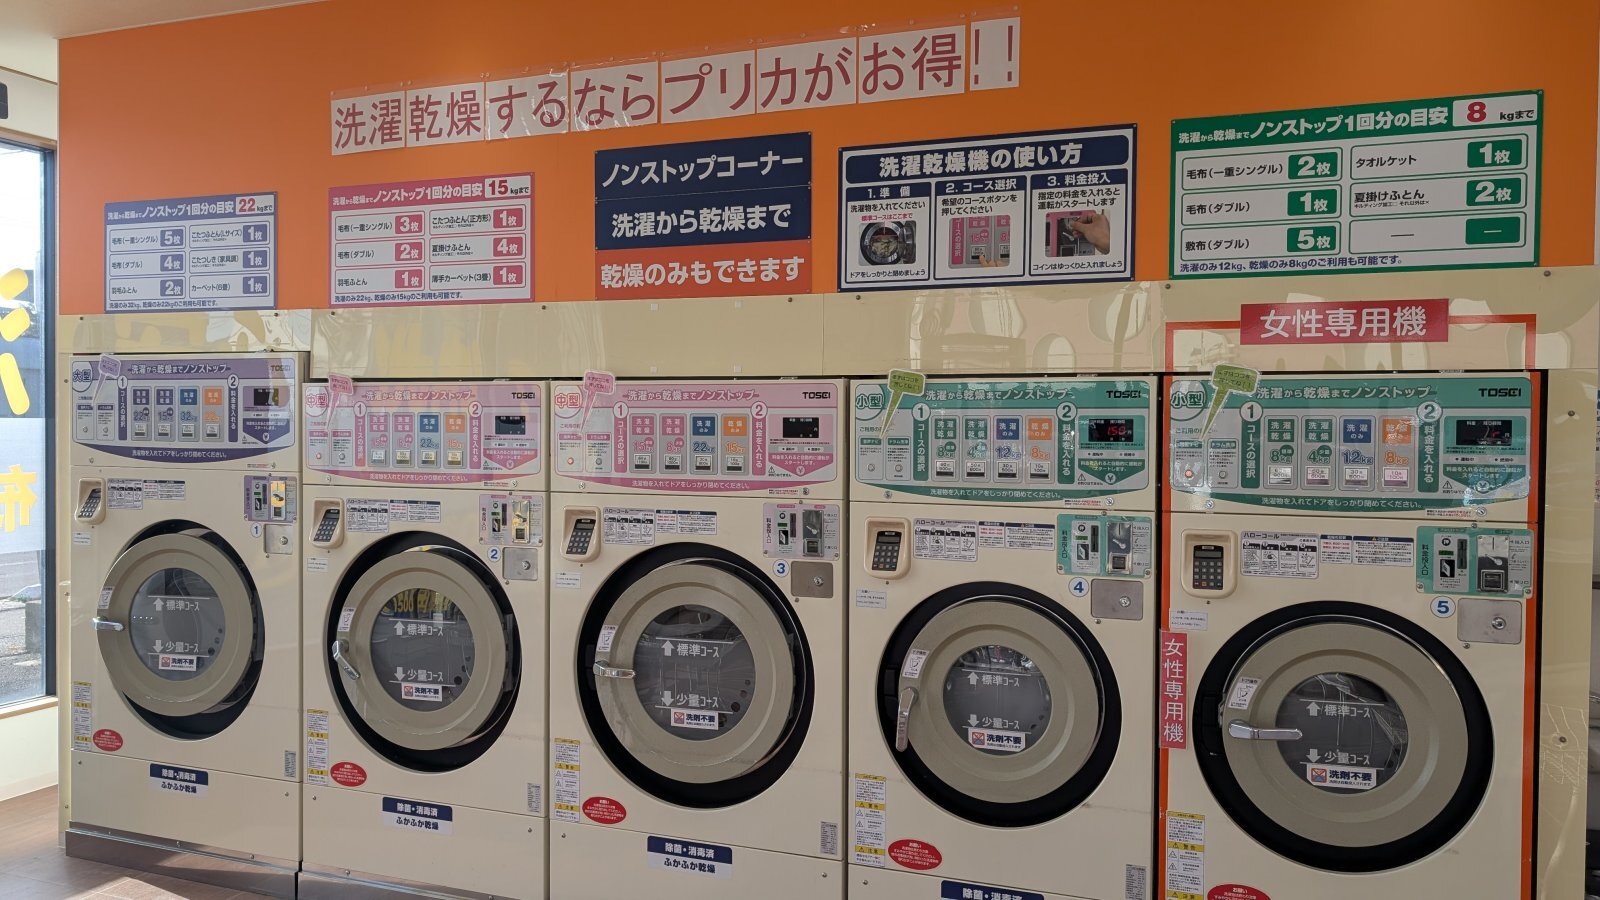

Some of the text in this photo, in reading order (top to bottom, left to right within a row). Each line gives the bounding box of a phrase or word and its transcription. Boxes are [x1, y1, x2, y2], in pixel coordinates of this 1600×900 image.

[1178, 102, 1534, 144] 洗濯から乾燥までノンストップ1回分の目安 8 kgまで
[879, 143, 1082, 178] 洗濯乾燥機の使い方
[1356, 143, 1510, 168] タオルケット 1枚
[602, 151, 803, 187] ノンストップコーナー
[1186, 156, 1331, 179] 毛布（一重シングル） 2枚
[962, 179, 1017, 192] コース選択
[1064, 173, 1110, 186] 料金投入
[489, 180, 508, 195] 15
[1038, 188, 1120, 200] 指定の料金を入れると
[1354, 181, 1512, 203] 夏掛けふとん 2枚
[238, 198, 255, 212] 22
[257, 204, 272, 212] kgまで
[850, 201, 926, 212] 洗濯物を入れてください
[942, 194, 1017, 206] 希望のコースボタンを
[1038, 198, 1116, 210] 運転がスタートします
[1186, 193, 1328, 215] 毛布（ダブル） 1枚
[942, 206, 992, 216] 押してください
[400, 217, 419, 232] 3枚
[500, 211, 516, 226] 1枚
[612, 204, 791, 238] 洗濯から乾燥まで
[164, 231, 181, 245] 5枚
[248, 227, 262, 240] 1枚
[432, 239, 517, 253] 夏掛けふとん 4枚
[1185, 230, 1331, 251] 敷布（ダブル） 5枚
[338, 244, 419, 259] 毛布（ダブル） 2枚
[164, 256, 181, 270] 4枚
[248, 252, 262, 265] 1枚
[1032, 260, 1122, 270] コインはゆっくりと入れましょう
[1180, 255, 1402, 272] 洗濯のみ12kg、乾燥のみ8kgのご利用も可能です。
[500, 267, 516, 282] 1枚
[601, 256, 805, 288] 乾燥のみもできます
[248, 278, 262, 292] 1枚
[338, 272, 419, 286] 羽毛ふとん 1枚
[165, 282, 181, 294] 2枚
[1260, 306, 1427, 339] 女性専用機
[73, 370, 92, 382] 大型
[230, 377, 236, 386] 2
[1257, 386, 1521, 399] 洗濯から乾燥までノンストップ TOSEI
[307, 393, 327, 408] 中型
[556, 393, 580, 408] 中型
[857, 394, 882, 409] 小型
[1172, 391, 1204, 408] 小型
[472, 404, 479, 414] 2
[618, 405, 622, 416] 1
[756, 405, 762, 416] 2
[918, 405, 923, 418] 1
[1062, 405, 1071, 418] 2
[1247, 405, 1254, 419] 1
[1424, 404, 1435, 419] 2
[1246, 425, 1255, 478] コースの選択
[1424, 426, 1434, 483] 料金を入れる
[1262, 498, 1422, 508] 洗濯物を入れてドアをしっかり閉めてください。
[254, 525, 259, 534] 1
[490, 548, 498, 559] 2
[777, 563, 785, 573] 3
[1074, 581, 1084, 593] 4
[166, 600, 199, 611] 標準コース
[1437, 601, 1449, 614] 5
[407, 624, 443, 636] 標準コース
[166, 641, 199, 653] 少量コース
[677, 644, 719, 658] 標準コース
[407, 669, 443, 681] 少量コース
[982, 674, 1020, 687] 標準コース
[1164, 638, 1184, 743] 女性専用機
[676, 693, 719, 708] 少量コース
[1325, 705, 1370, 717] 標準コース
[686, 714, 715, 723] 洗剤不要
[982, 717, 1020, 730] 少量コース
[987, 734, 1021, 745] 洗剤不要
[1325, 751, 1370, 764] 少量コース
[1329, 770, 1372, 781] 洗剤不要
[396, 817, 438, 830] ふかふか乾燥
[665, 843, 715, 860] 除菌・消毒済
[664, 857, 715, 874] ふかふか乾燥
